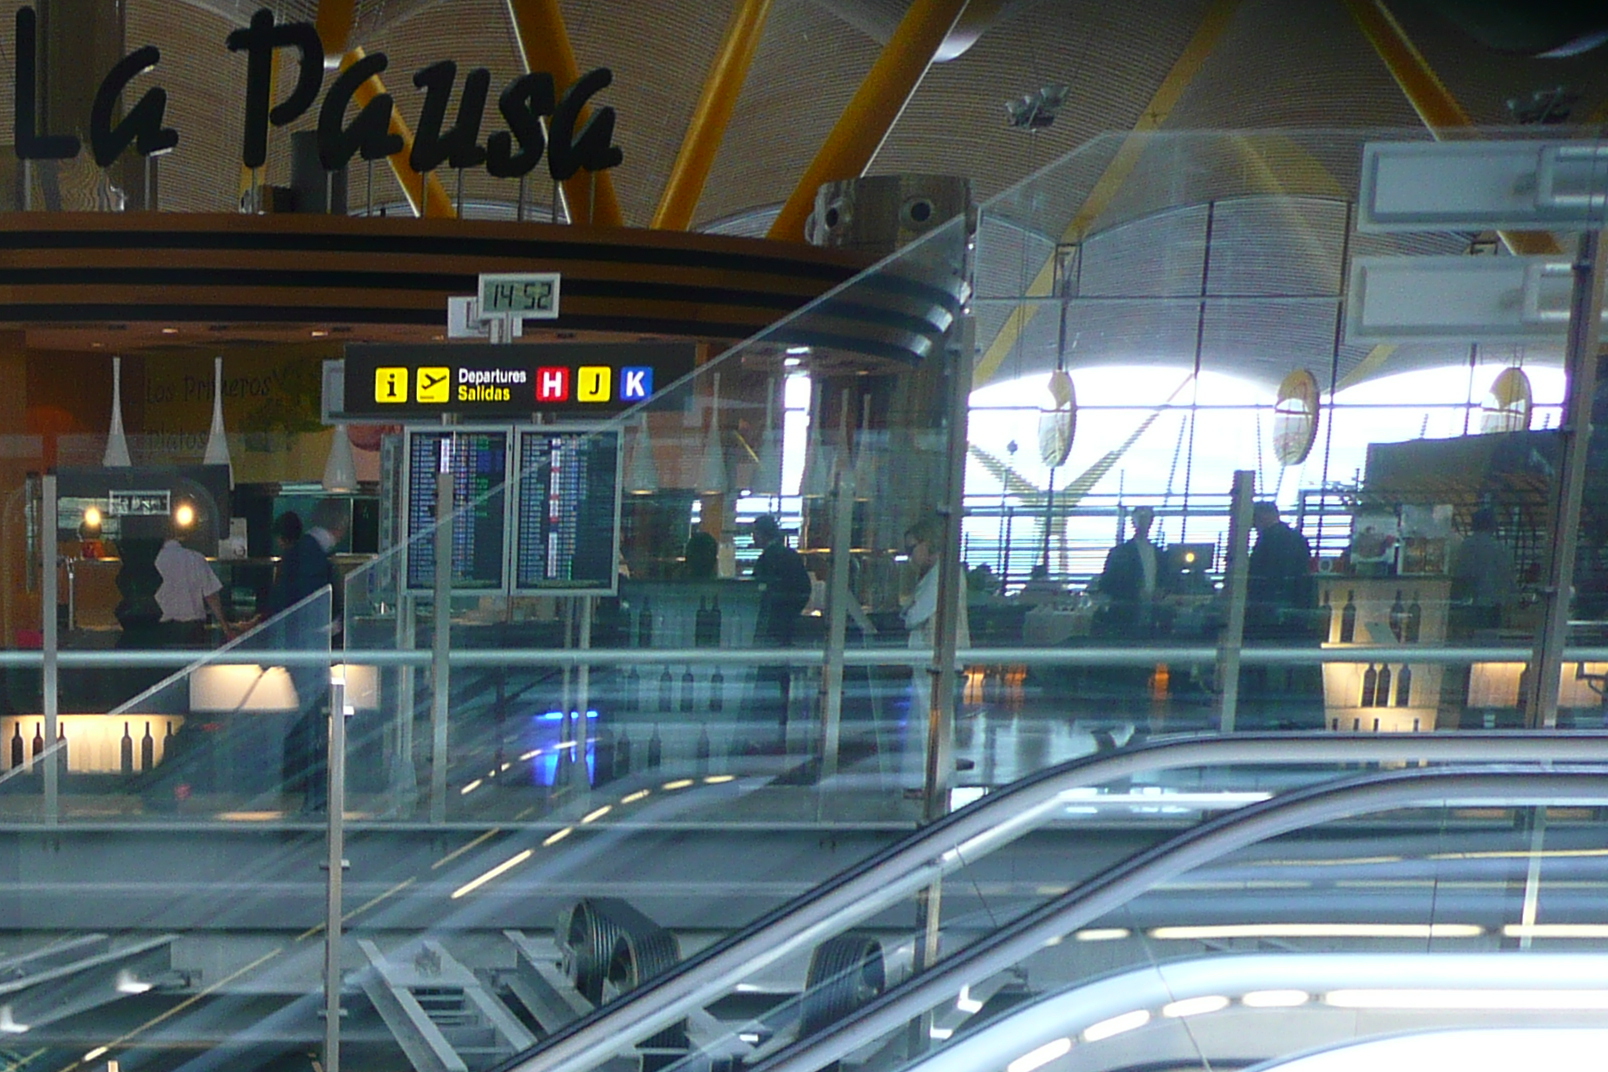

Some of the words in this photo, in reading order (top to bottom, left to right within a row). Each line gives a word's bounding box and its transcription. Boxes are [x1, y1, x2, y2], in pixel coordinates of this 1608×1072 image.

[14, 6, 180, 168] La
[224, 8, 624, 182] Pausa
[457, 367, 528, 386] Departures
[542, 370, 563, 398] H
[589, 372, 602, 396] J
[625, 370, 646, 397] K
[457, 385, 511, 402] Salidas
